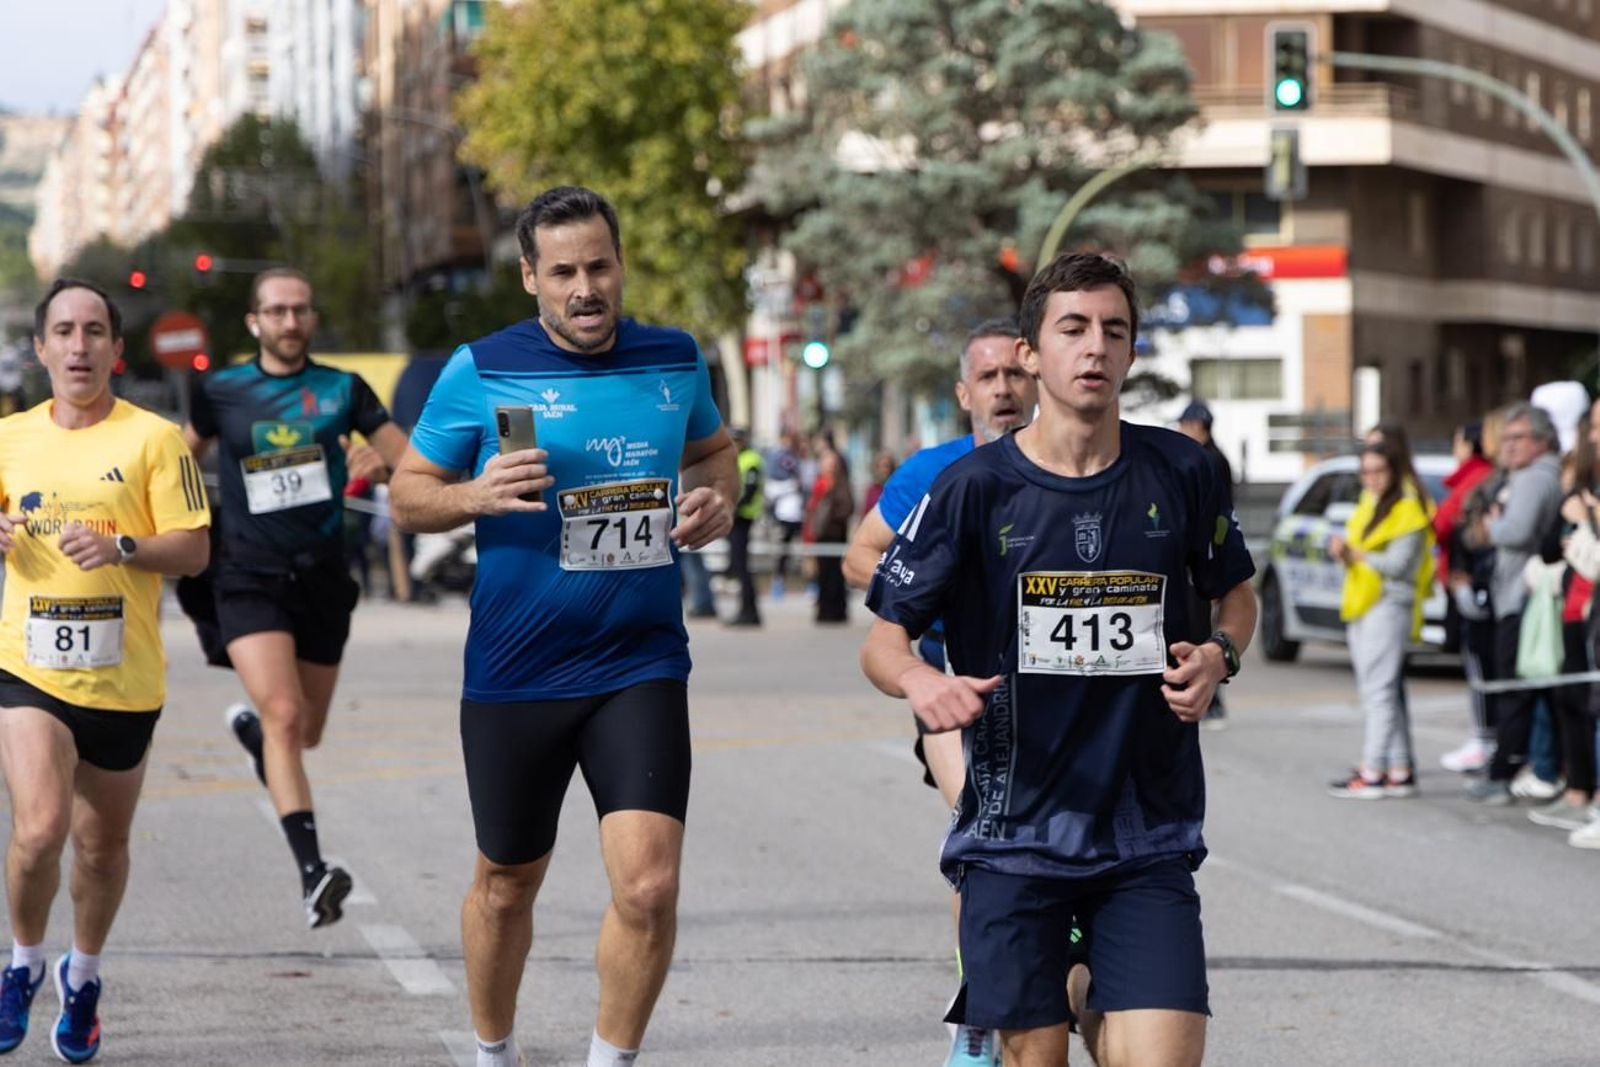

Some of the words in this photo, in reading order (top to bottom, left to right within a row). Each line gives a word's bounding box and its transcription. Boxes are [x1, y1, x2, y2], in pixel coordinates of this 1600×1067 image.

[529, 404, 547, 412] AJA
[627, 441, 649, 449] MEDIA
[271, 470, 302, 494] 39
[564, 490, 588, 511] XV
[602, 493, 625, 505] gran
[587, 514, 652, 550] 714
[1025, 576, 1057, 595] XXV
[1059, 577, 1107, 587] CARRERA
[1109, 576, 1159, 585] POPULAR
[1072, 586, 1100, 597] gran
[1106, 584, 1158, 593] caminata
[55, 625, 91, 652] 81
[1050, 612, 1134, 651] 413
[964, 820, 1006, 842] AEN
